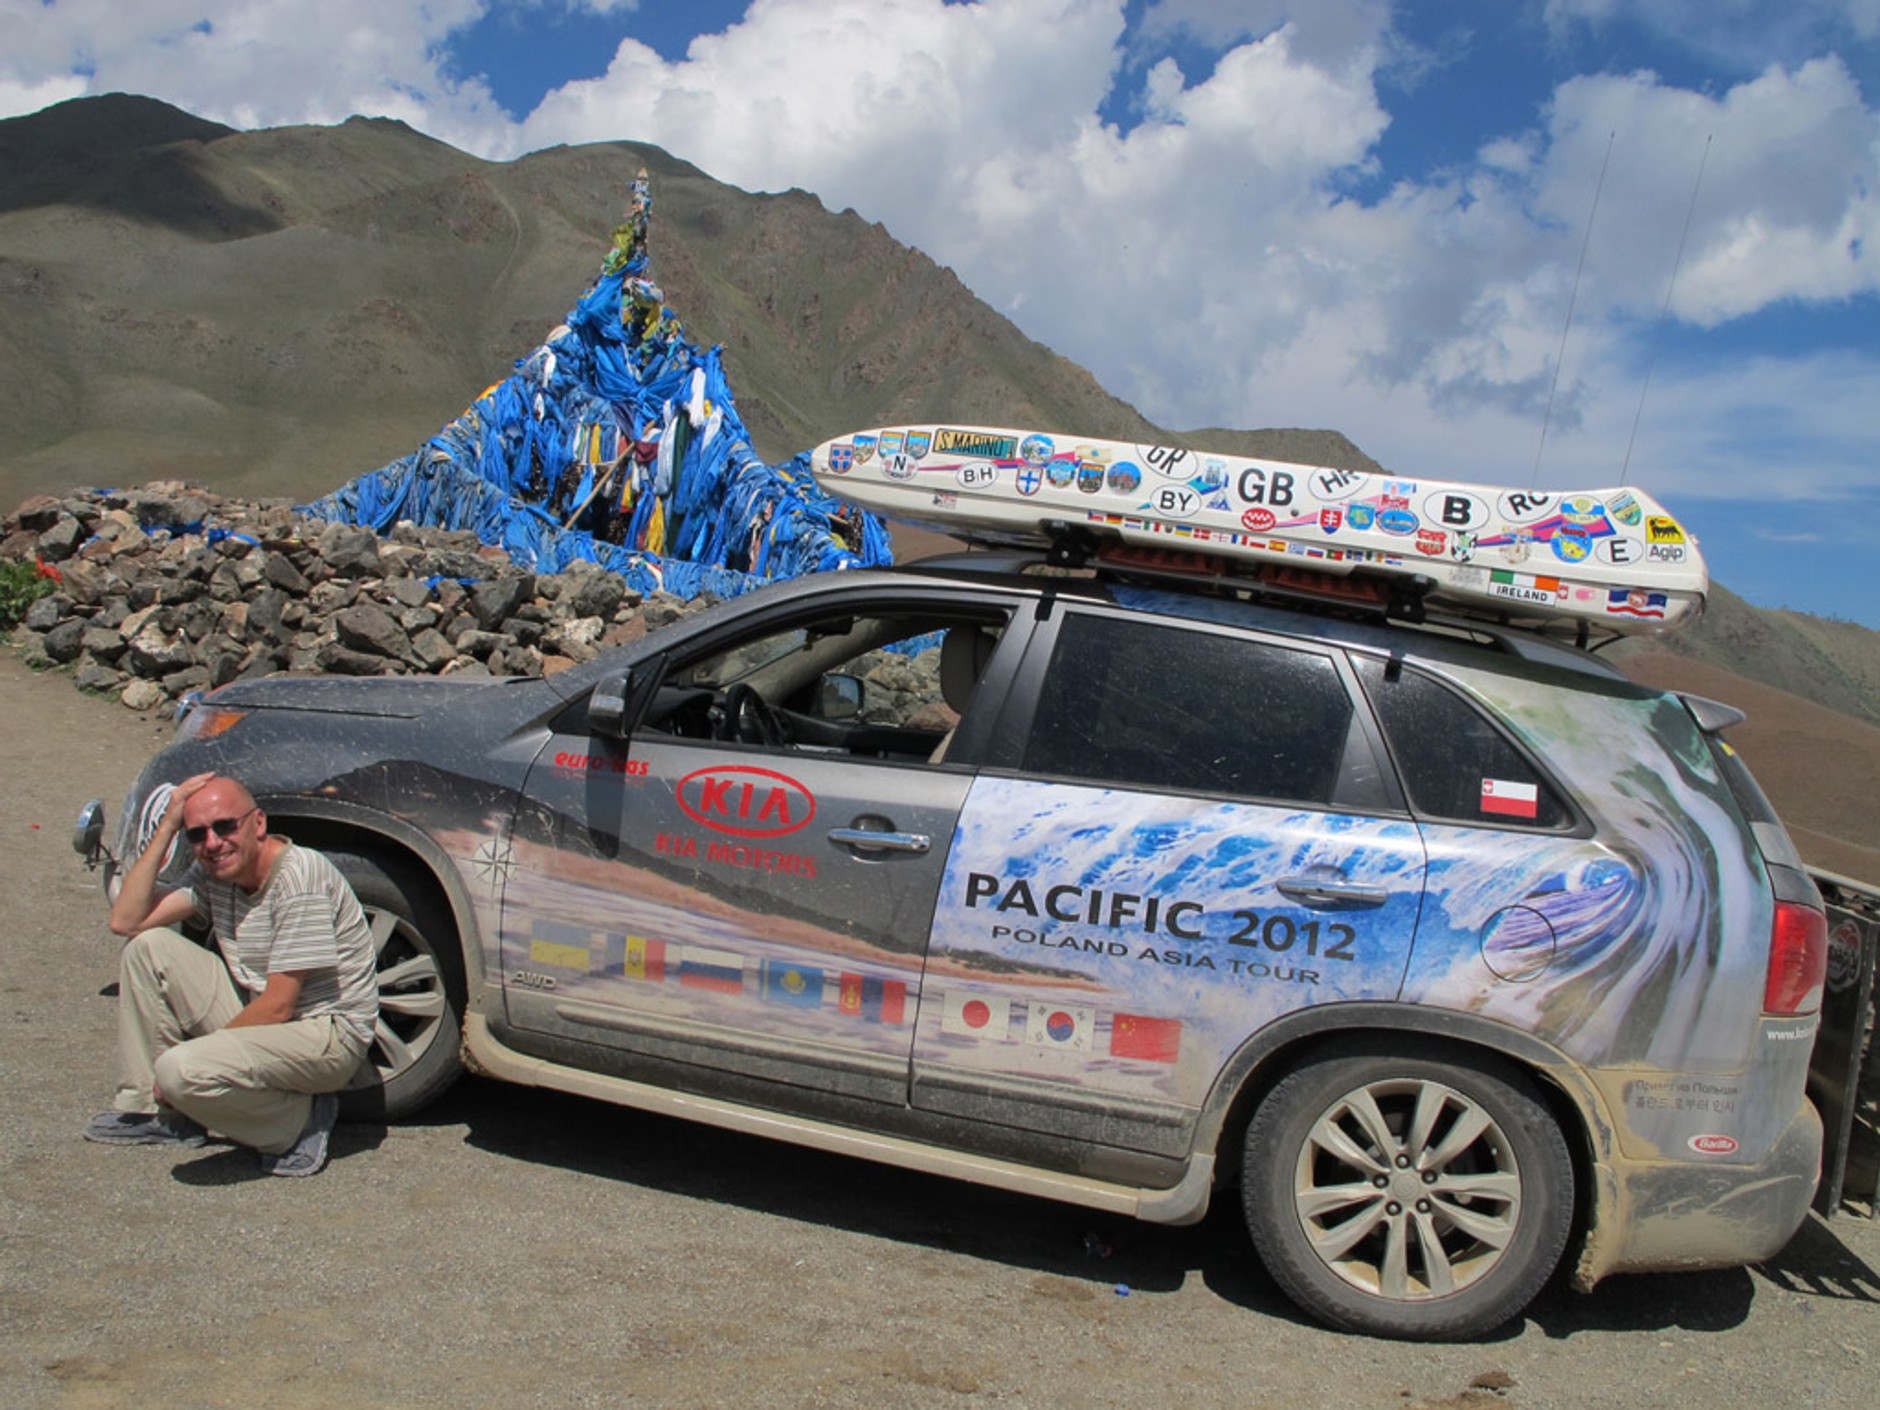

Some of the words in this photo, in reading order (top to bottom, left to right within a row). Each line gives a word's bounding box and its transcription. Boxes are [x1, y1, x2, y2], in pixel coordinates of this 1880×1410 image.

[893, 456, 906, 470] N
[1147, 446, 1187, 474] GR
[1160, 491, 1192, 511] BY
[1238, 468, 1294, 506] GB
[1443, 496, 1470, 524] B
[1610, 540, 1629, 562] E
[1649, 545, 1683, 561] Agip
[1496, 585, 1548, 602] IRELAND
[700, 777, 791, 824] KIA
[655, 833, 698, 859] KIA
[707, 843, 818, 879] MOTORS
[965, 872, 1205, 939] PACIFIC
[1228, 910, 1356, 962] 2012
[992, 925, 1128, 957] POLAND
[1138, 946, 1217, 971] ASIA
[1225, 958, 1320, 985] TOUR
[510, 970, 557, 991] AWD
